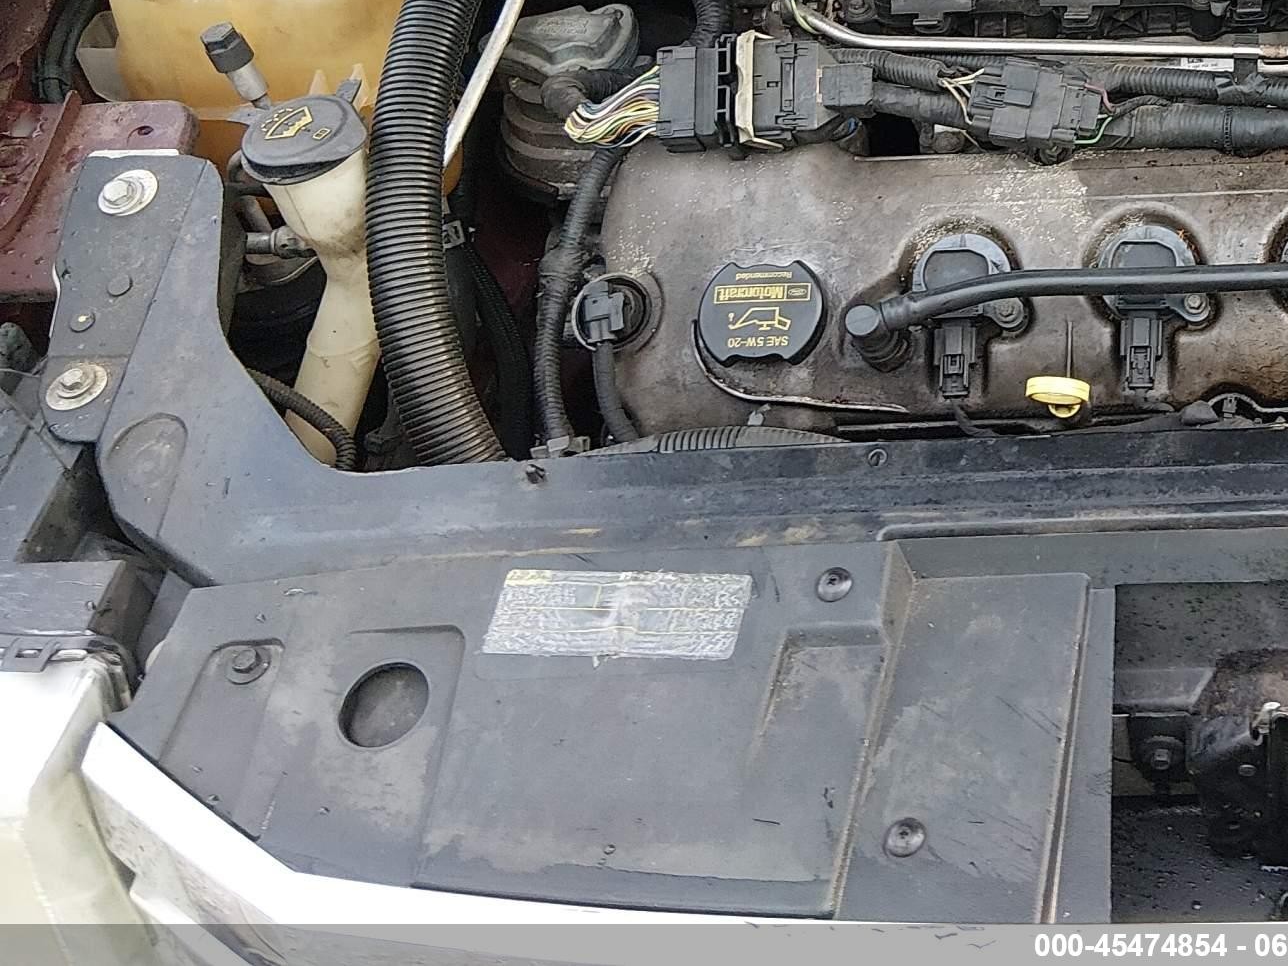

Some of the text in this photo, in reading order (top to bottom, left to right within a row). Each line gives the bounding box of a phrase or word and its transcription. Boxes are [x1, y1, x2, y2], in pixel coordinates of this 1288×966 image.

[735, 271, 792, 280] Recommended
[719, 286, 784, 300] Motorcraft
[728, 335, 789, 348] SAE 5W-20
